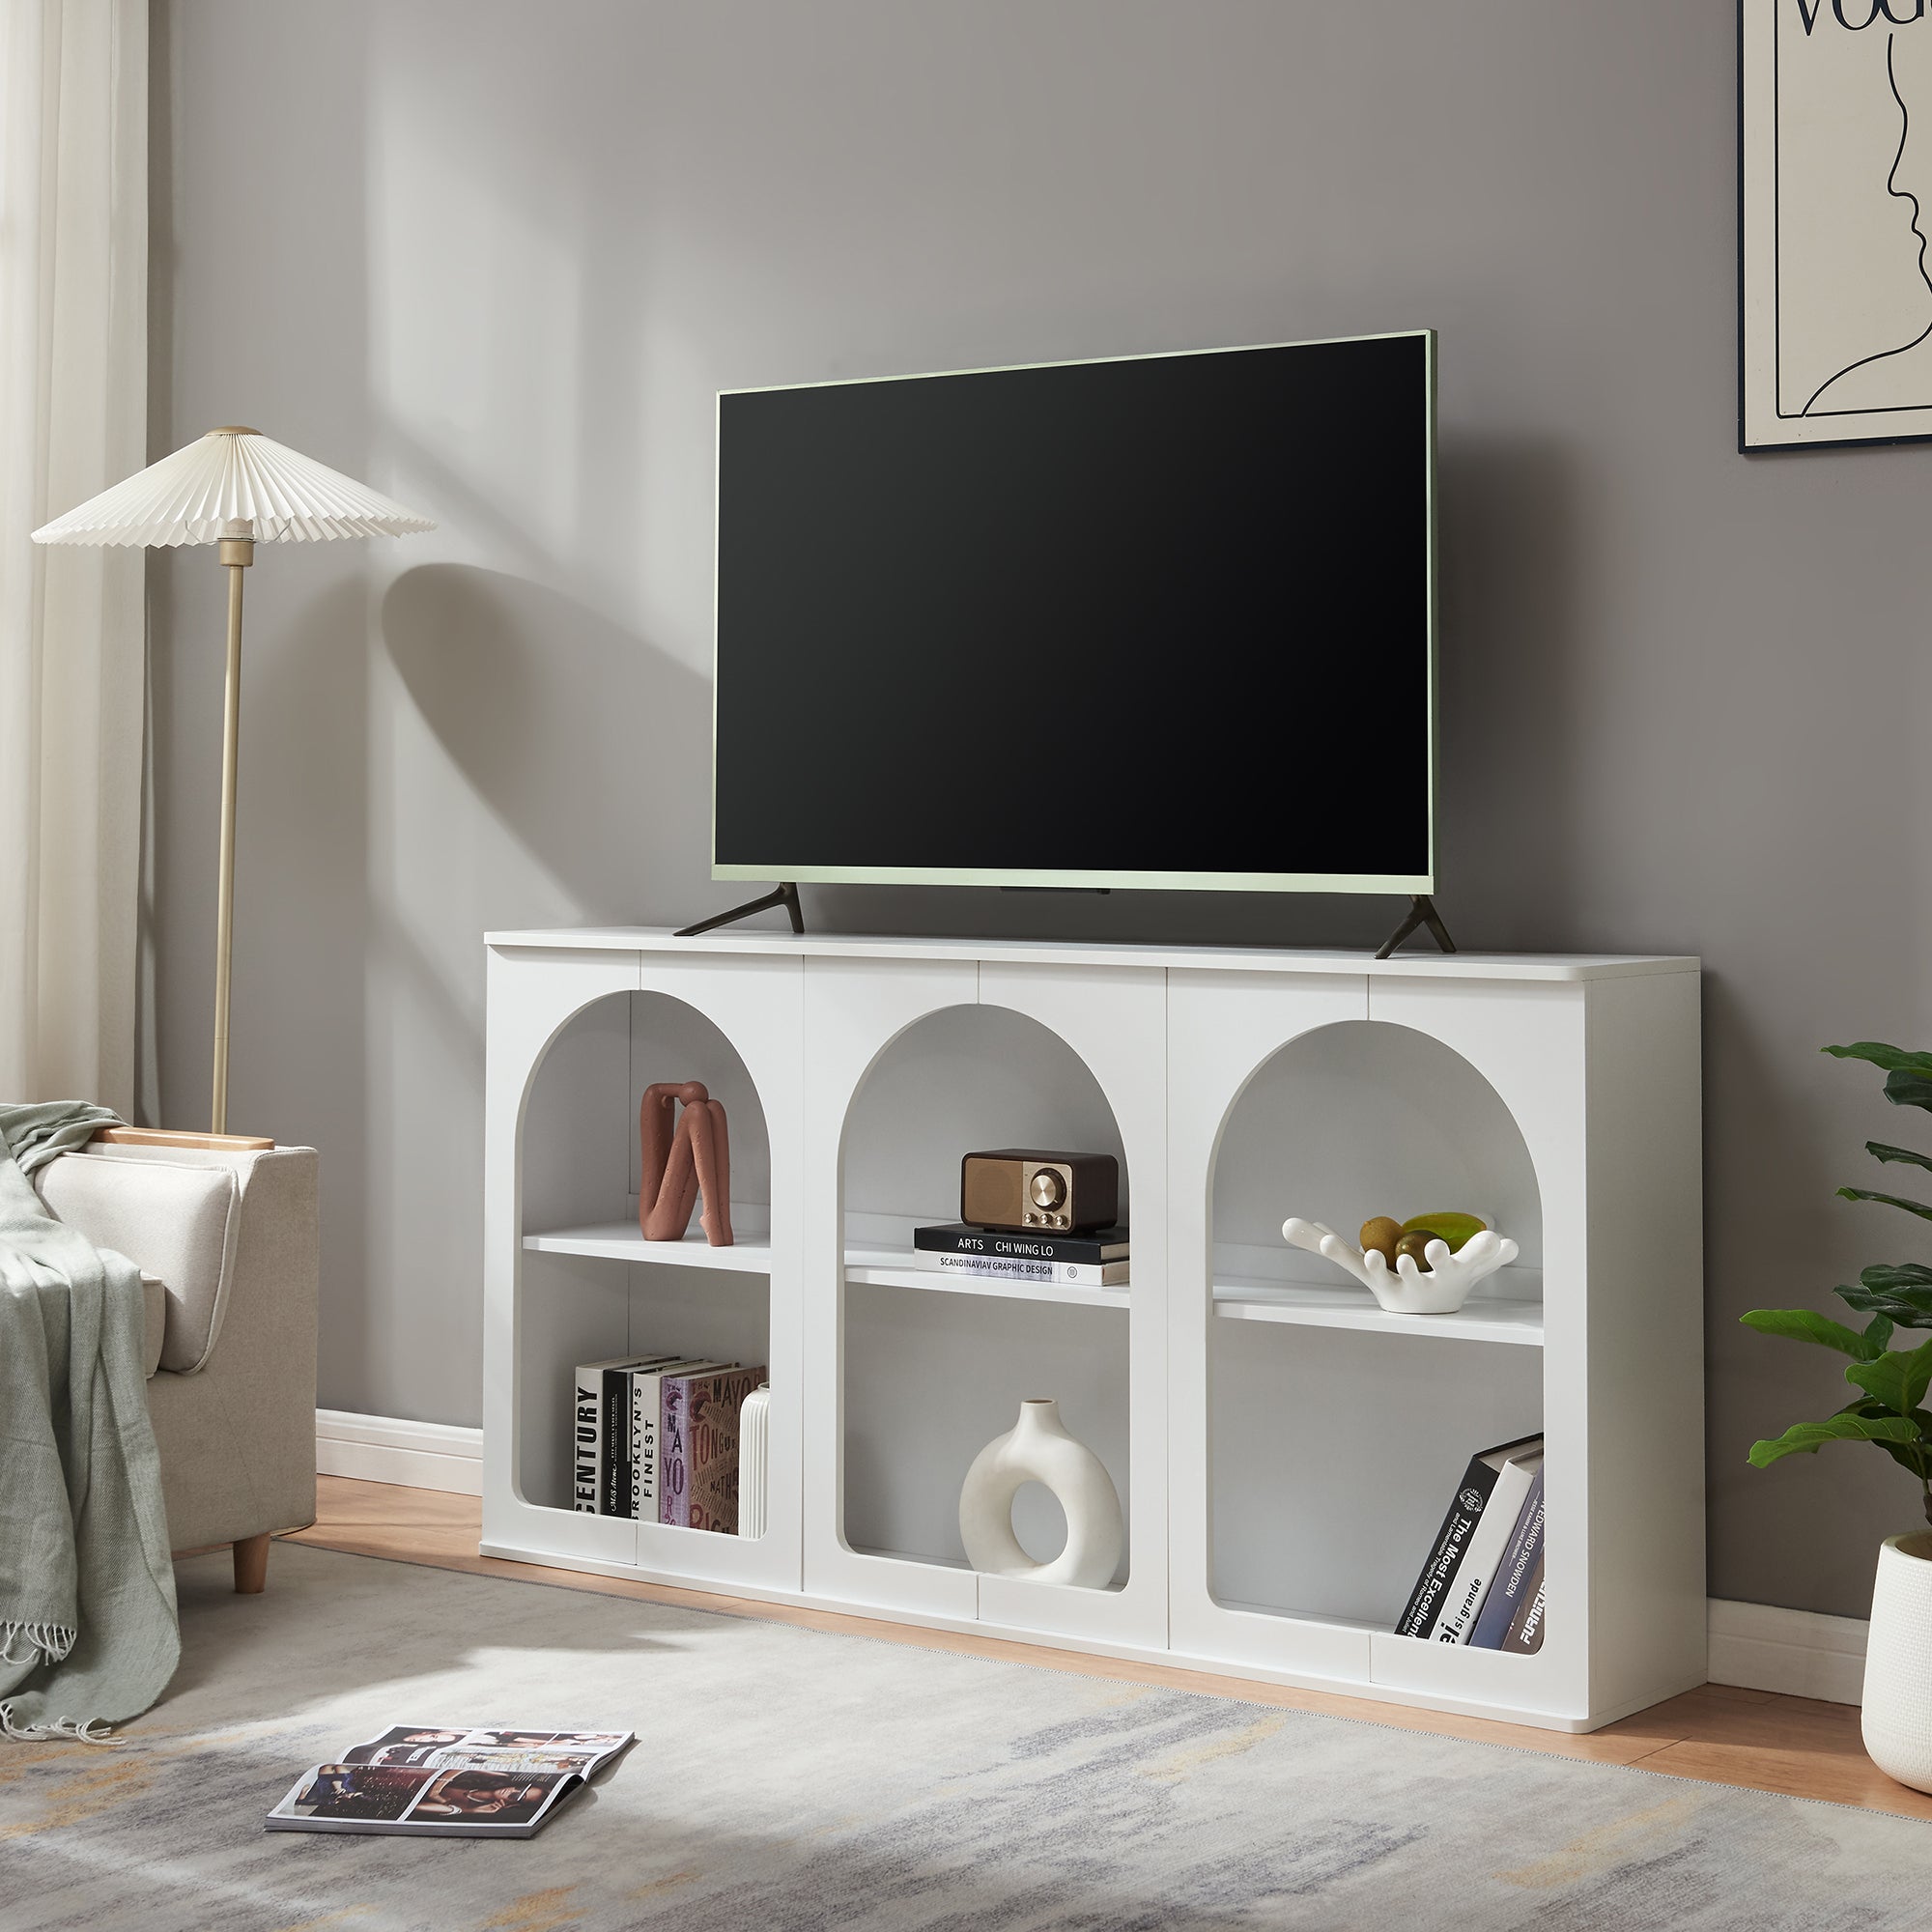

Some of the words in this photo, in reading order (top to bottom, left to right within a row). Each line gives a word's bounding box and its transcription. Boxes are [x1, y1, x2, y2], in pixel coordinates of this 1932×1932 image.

[957, 1237, 984, 1251] ARTS
[995, 1240, 1011, 1253] CHI
[1013, 1242, 1039, 1256] WING
[1040, 1244, 1054, 1257] LO
[992, 1262, 1024, 1273] GRAPHIC
[1025, 1264, 1053, 1275] DESIGN
[643, 1419, 654, 1498] FINEST
[1453, 1518, 1472, 1543] The
[1525, 1509, 1545, 1550] EDWARD
[1435, 1547, 1460, 1578] Most
[1505, 1548, 1530, 1598] SNOWDEN
[1455, 1616, 1464, 1630] si
[1460, 1577, 1482, 1620] grande
